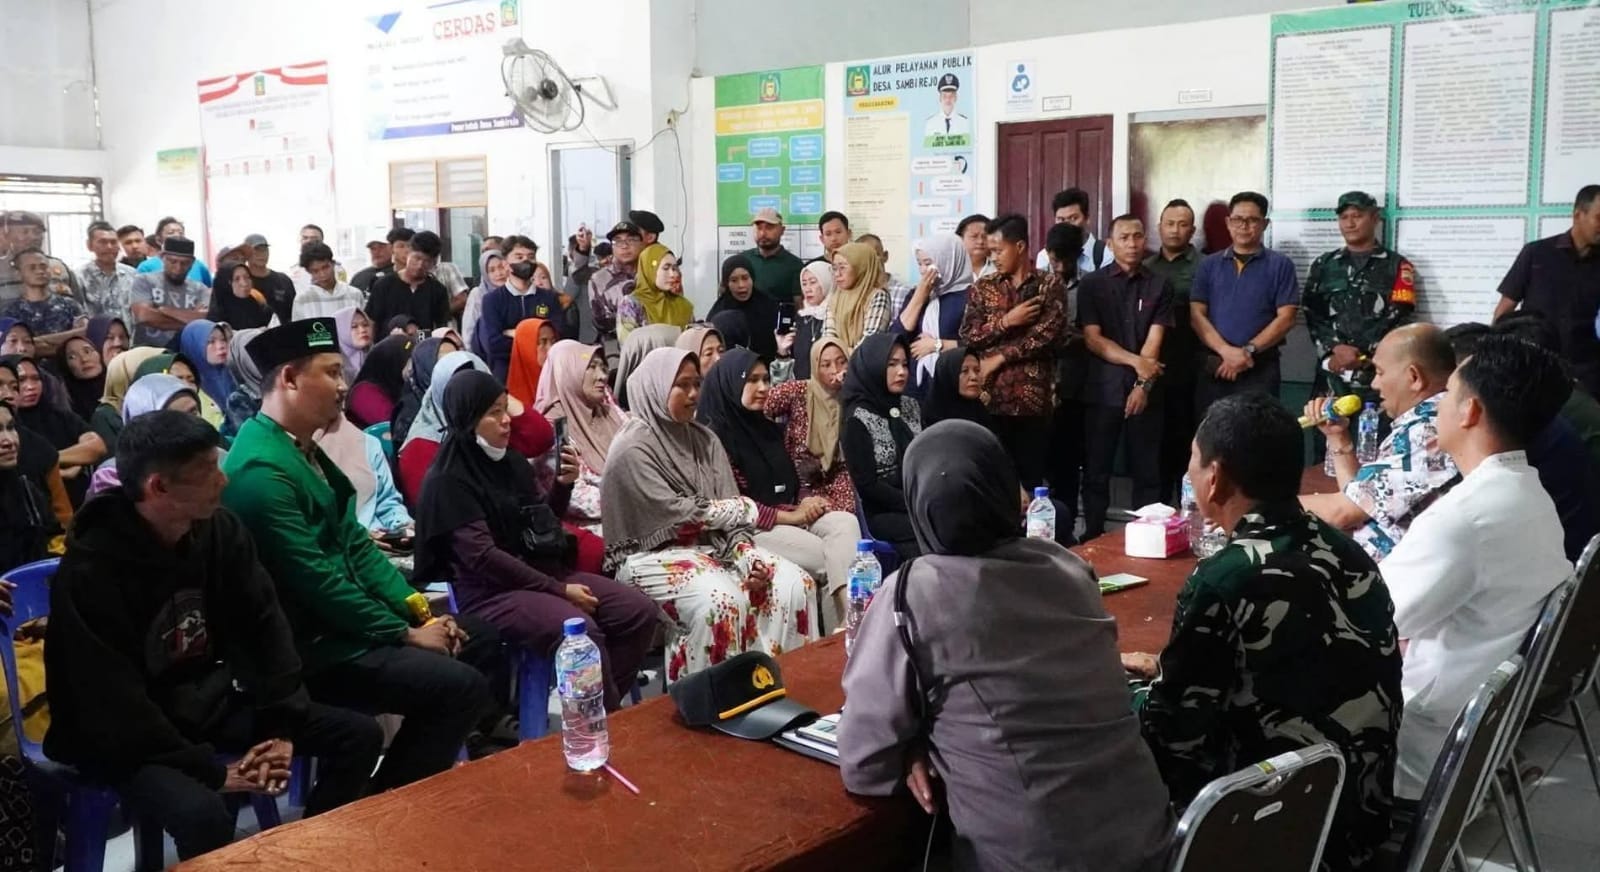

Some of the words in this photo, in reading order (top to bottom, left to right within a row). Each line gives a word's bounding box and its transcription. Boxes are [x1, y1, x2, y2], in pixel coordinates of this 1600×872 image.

[433, 12, 496, 40] CERDAS
[873, 64, 892, 76] ALUR
[895, 59, 938, 74] PELAYANAN
[942, 55, 973, 69] PUBLIK
[873, 80, 892, 93] DESA
[895, 76, 938, 91] SAMBIREJO
